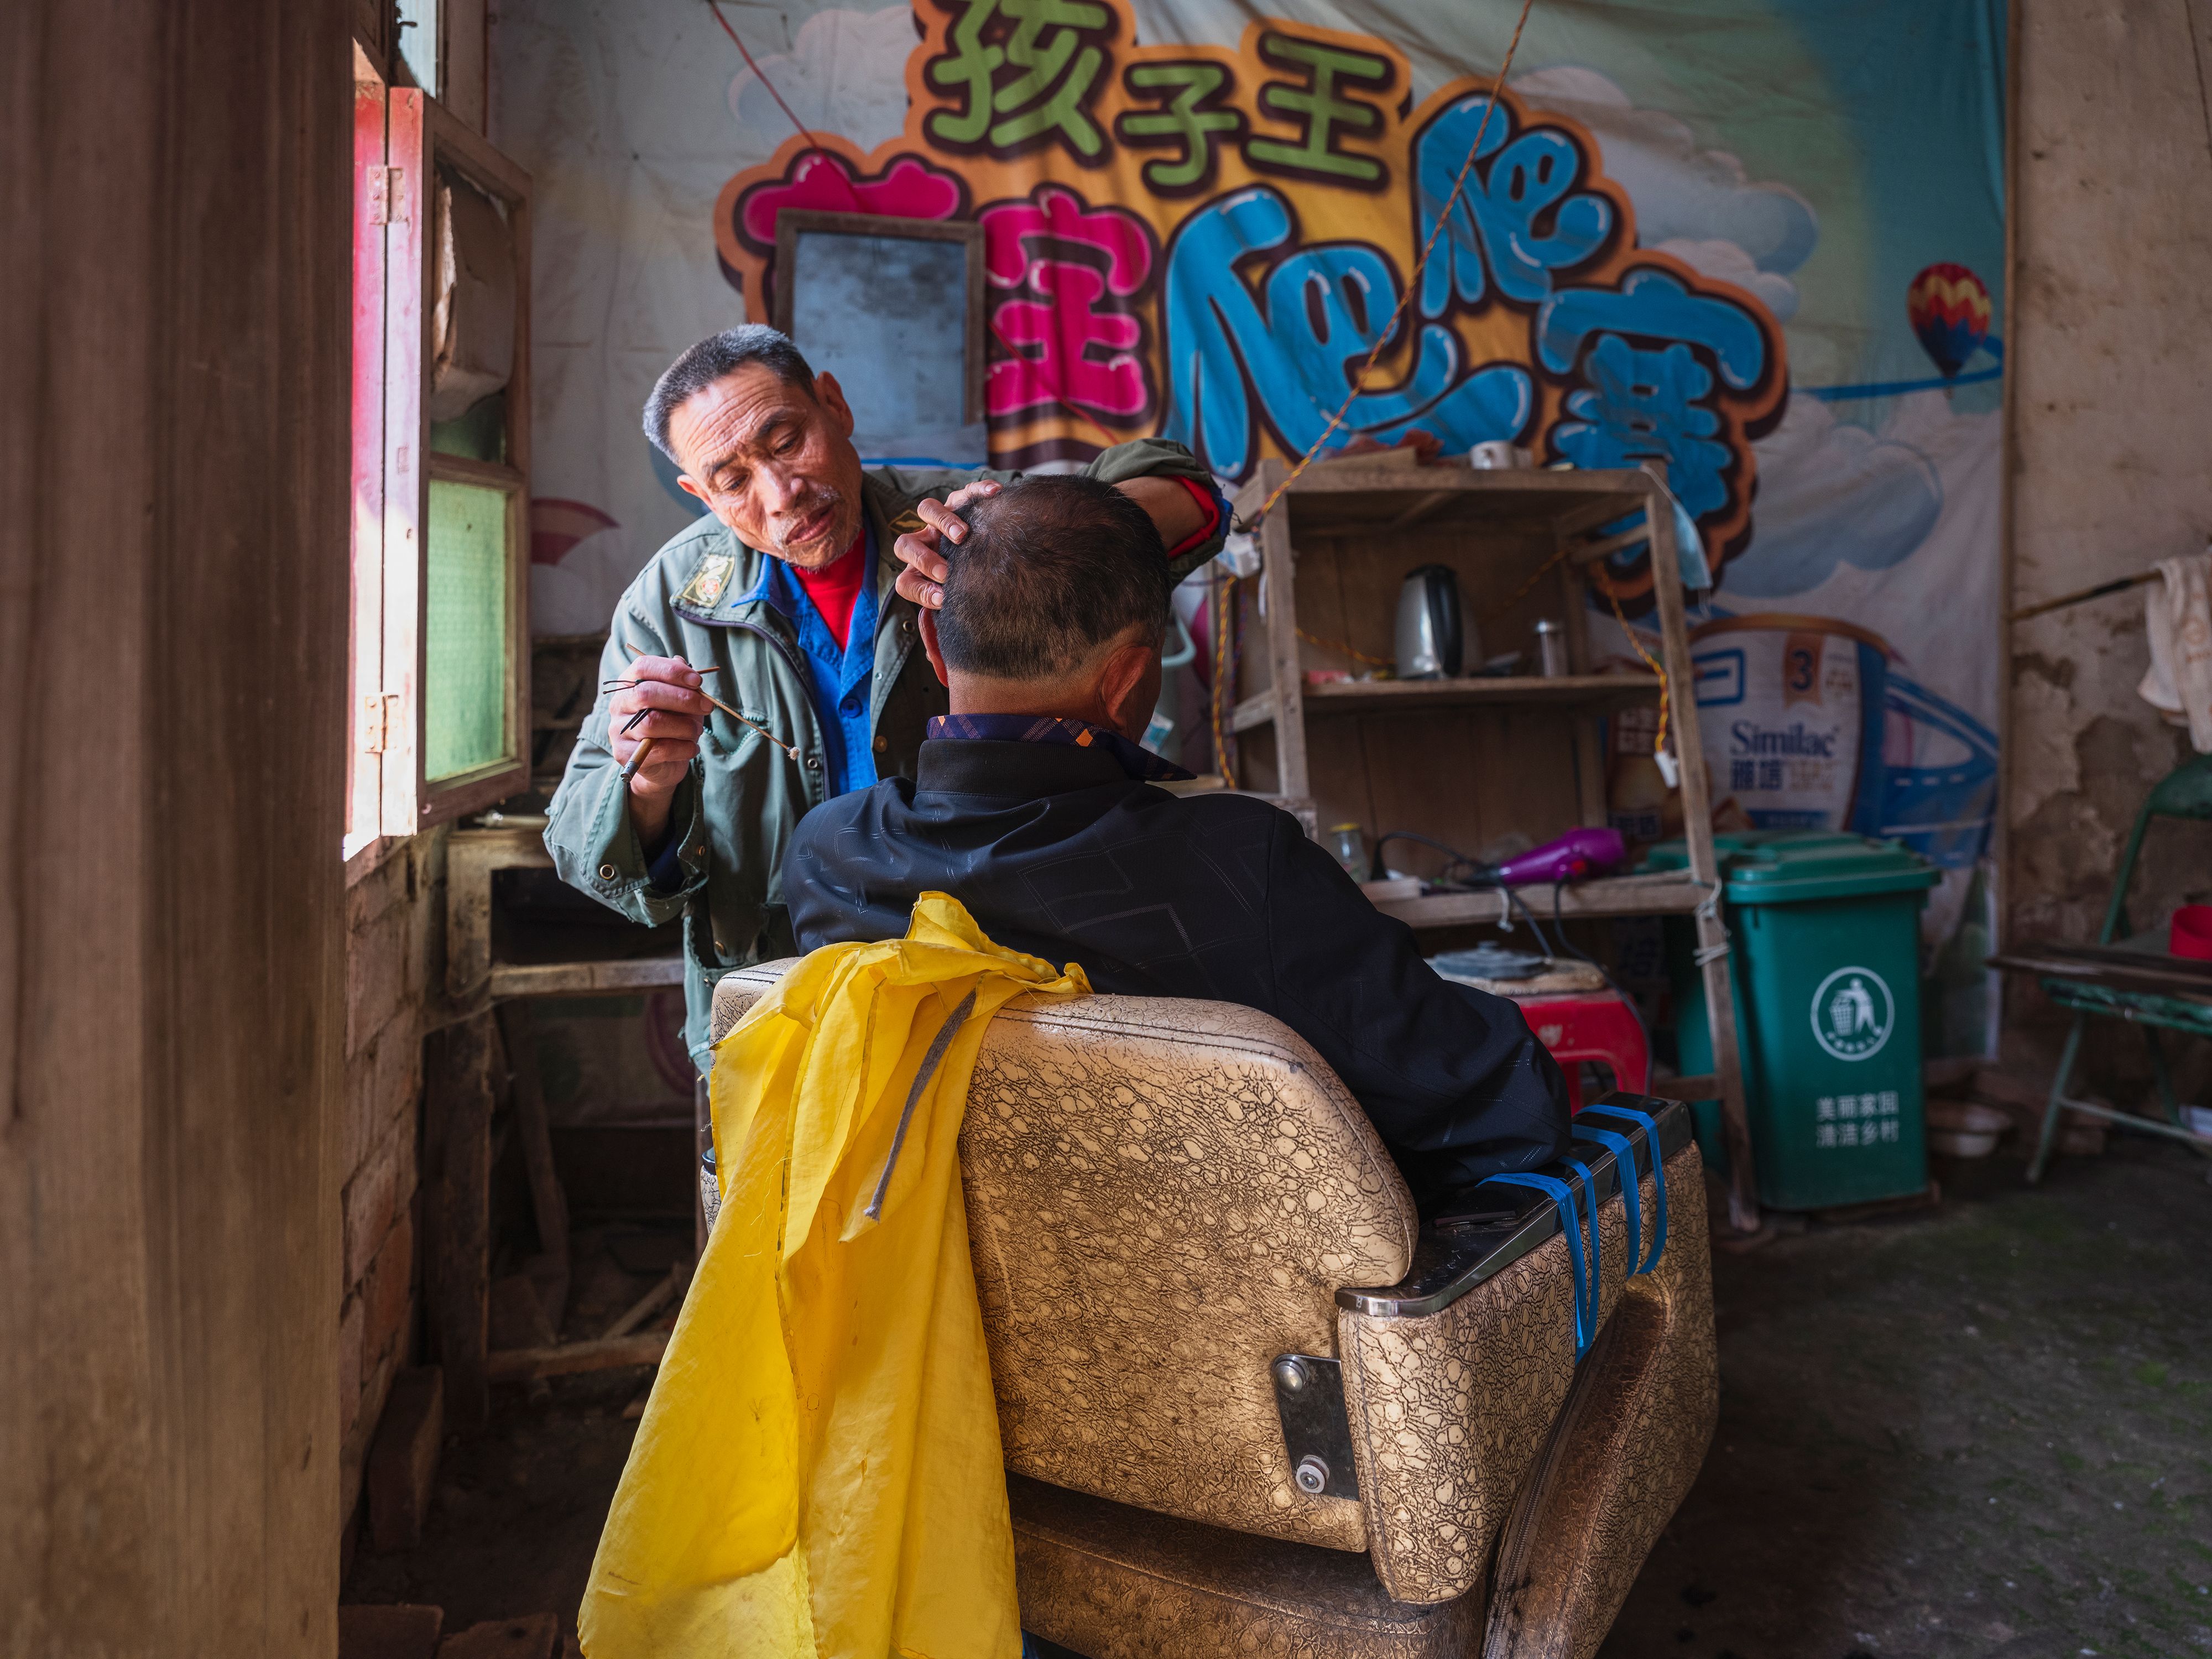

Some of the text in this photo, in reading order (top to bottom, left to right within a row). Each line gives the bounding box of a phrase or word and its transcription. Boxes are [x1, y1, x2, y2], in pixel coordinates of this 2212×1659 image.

[930, 0, 1387, 186] 孩子王
[742, 92, 1765, 566] 宝爬爬赛
[1791, 648, 1814, 691] 3
[1729, 720, 1837, 758] Similac
[1816, 1091, 1899, 1122] 美丽家园
[1816, 1118, 1899, 1149] 清洁乡村
